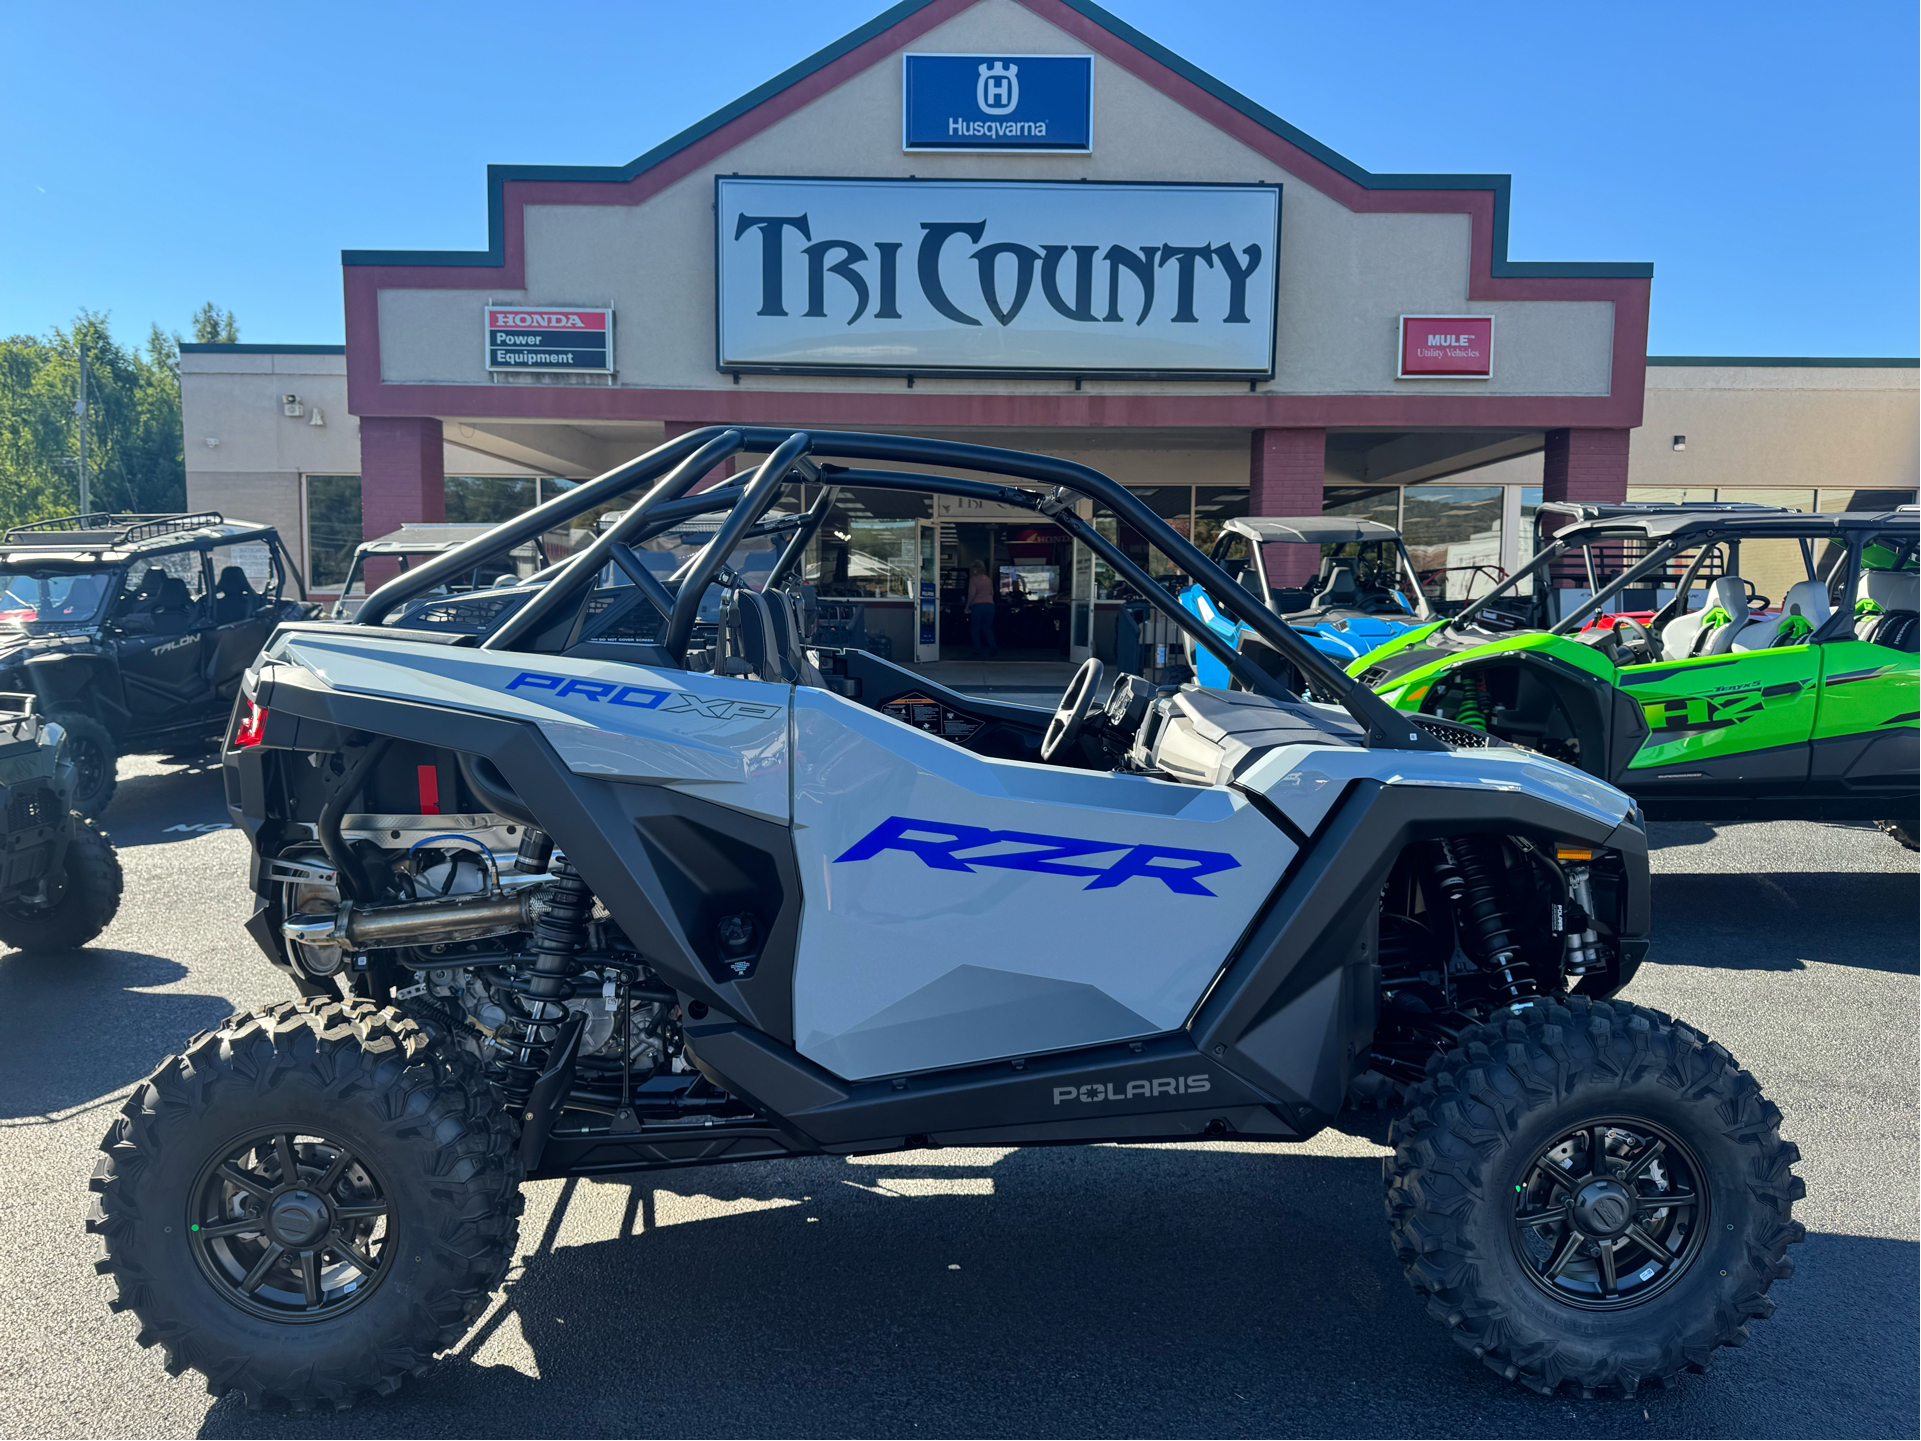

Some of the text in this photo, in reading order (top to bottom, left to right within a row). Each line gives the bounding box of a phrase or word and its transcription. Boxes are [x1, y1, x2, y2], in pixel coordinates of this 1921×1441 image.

[948, 117, 1047, 139] Husqvarna
[734, 211, 1263, 328] TRI COUNTY
[495, 313, 585, 327] HONDA
[496, 332, 542, 345] Power
[496, 350, 574, 365] Equipment
[1417, 348, 1480, 359] Utility Vehicles
[1037, 535, 1074, 544] HOND
[150, 632, 202, 656] TALON
[504, 671, 782, 720] PRO XP
[832, 815, 1243, 898] RZR
[1053, 1073, 1211, 1105] POLARIS
